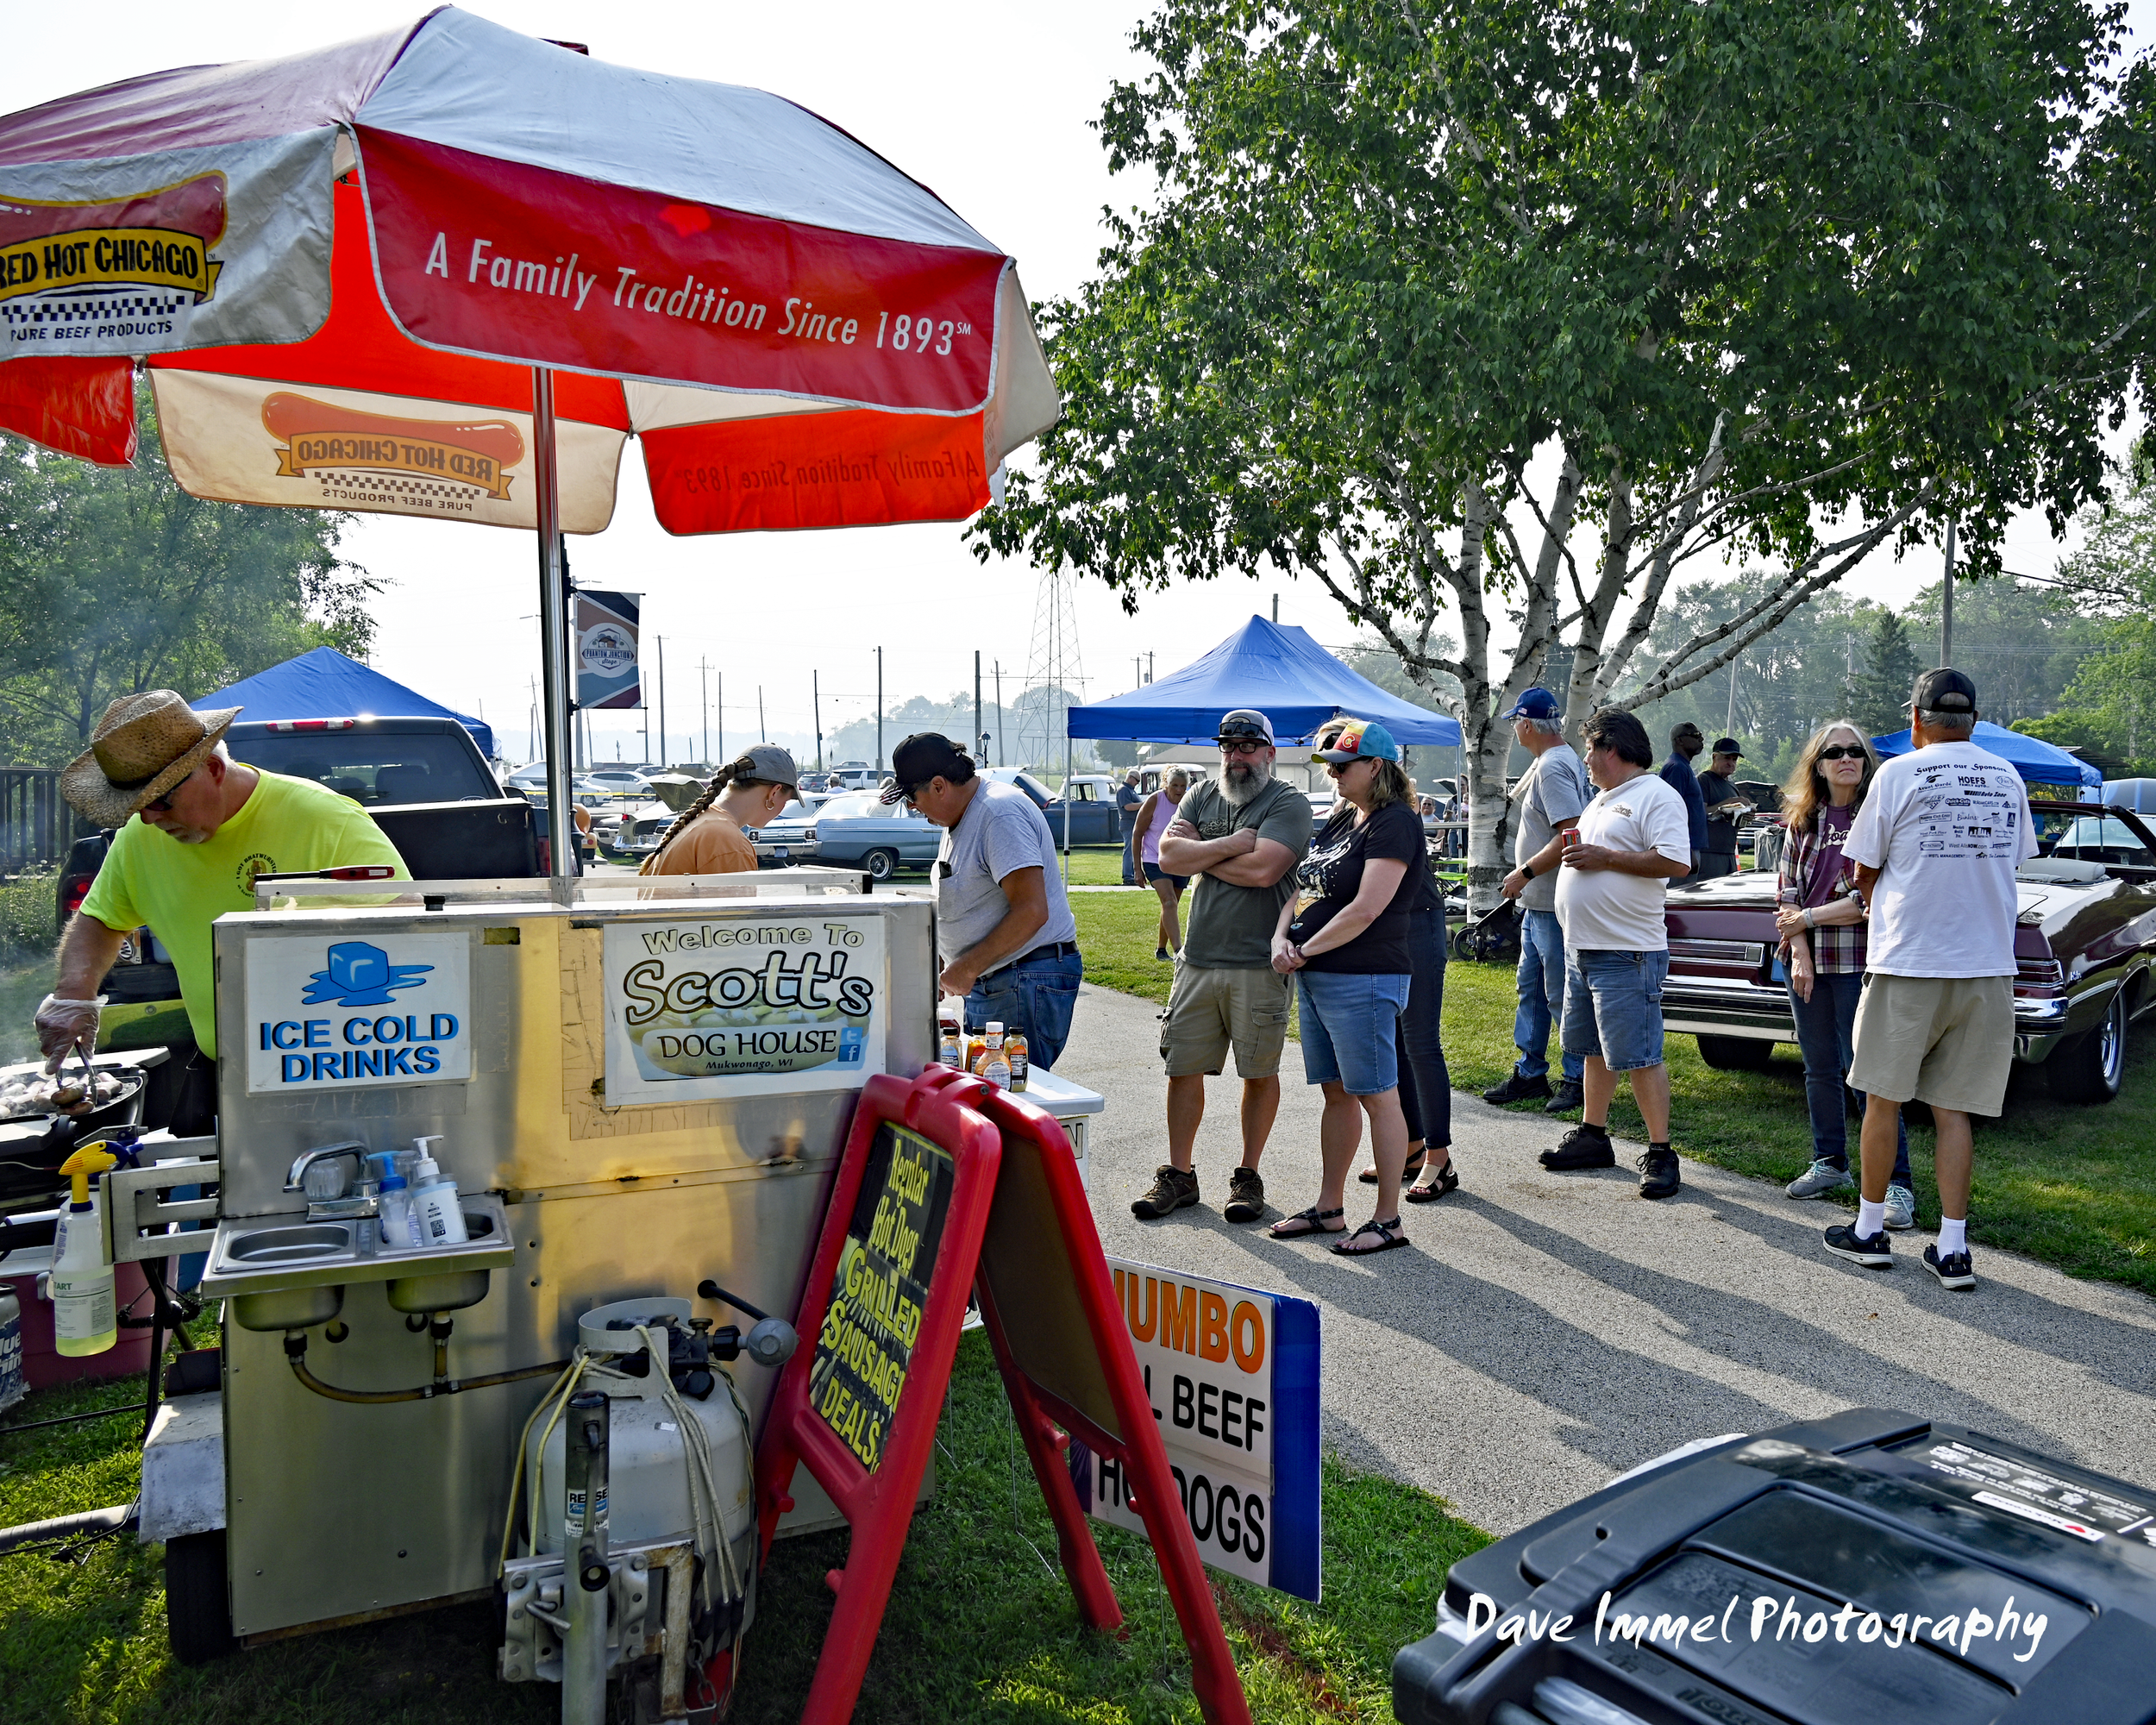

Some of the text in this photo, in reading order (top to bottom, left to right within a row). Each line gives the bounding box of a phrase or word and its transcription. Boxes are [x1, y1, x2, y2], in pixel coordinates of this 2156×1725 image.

[43, 242, 91, 280] HOT
[93, 236, 199, 279] CHICAGO
[425, 232, 448, 278] A
[468, 238, 598, 311] Family
[614, 267, 767, 331] Tradition
[778, 298, 858, 345] Since
[876, 311, 955, 355] 1893
[10, 320, 172, 342] PURE BEEF PRODUCTS
[586, 649, 630, 660] PHANTOM JUNCTION
[1914, 764, 1950, 775] Support
[642, 923, 864, 955] Welcome To
[624, 950, 874, 1026] Scott's
[260, 1013, 459, 1051] ICE COLD
[657, 1030, 837, 1058] DOG HOUSE
[281, 1046, 441, 1082] DRINKS
[705, 1058, 793, 1070] Mukwonago, WI
[888, 1138, 930, 1208] Regular
[871, 1195, 919, 1276] Hot Dogs
[845, 1247, 921, 1350] GRILLED
[1173, 1374, 1266, 1452] BEEF
[569, 1488, 607, 1502] RESE
